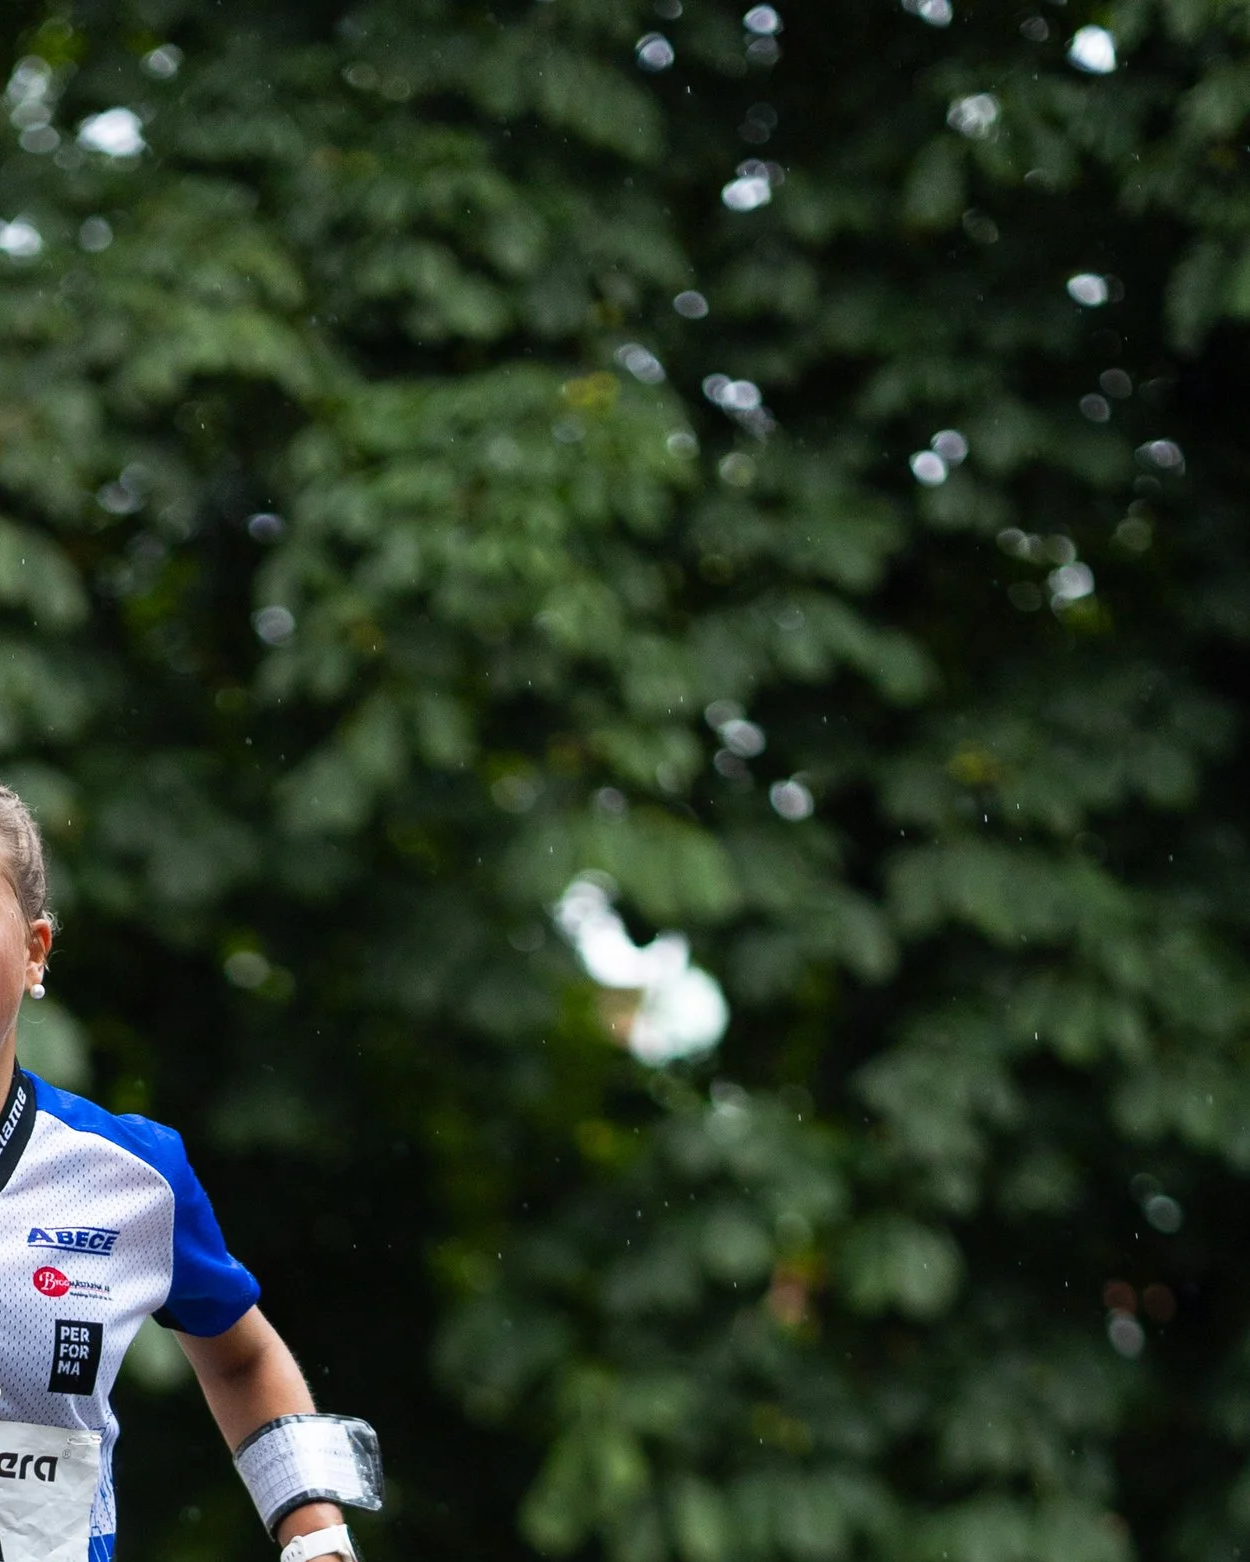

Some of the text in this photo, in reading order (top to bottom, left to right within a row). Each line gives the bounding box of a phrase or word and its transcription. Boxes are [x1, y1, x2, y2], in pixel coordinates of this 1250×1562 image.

[27, 1228, 117, 1250] ABECE
[61, 1326, 90, 1343] PER
[59, 1343, 89, 1359] FOR
[57, 1360, 80, 1376] MA
